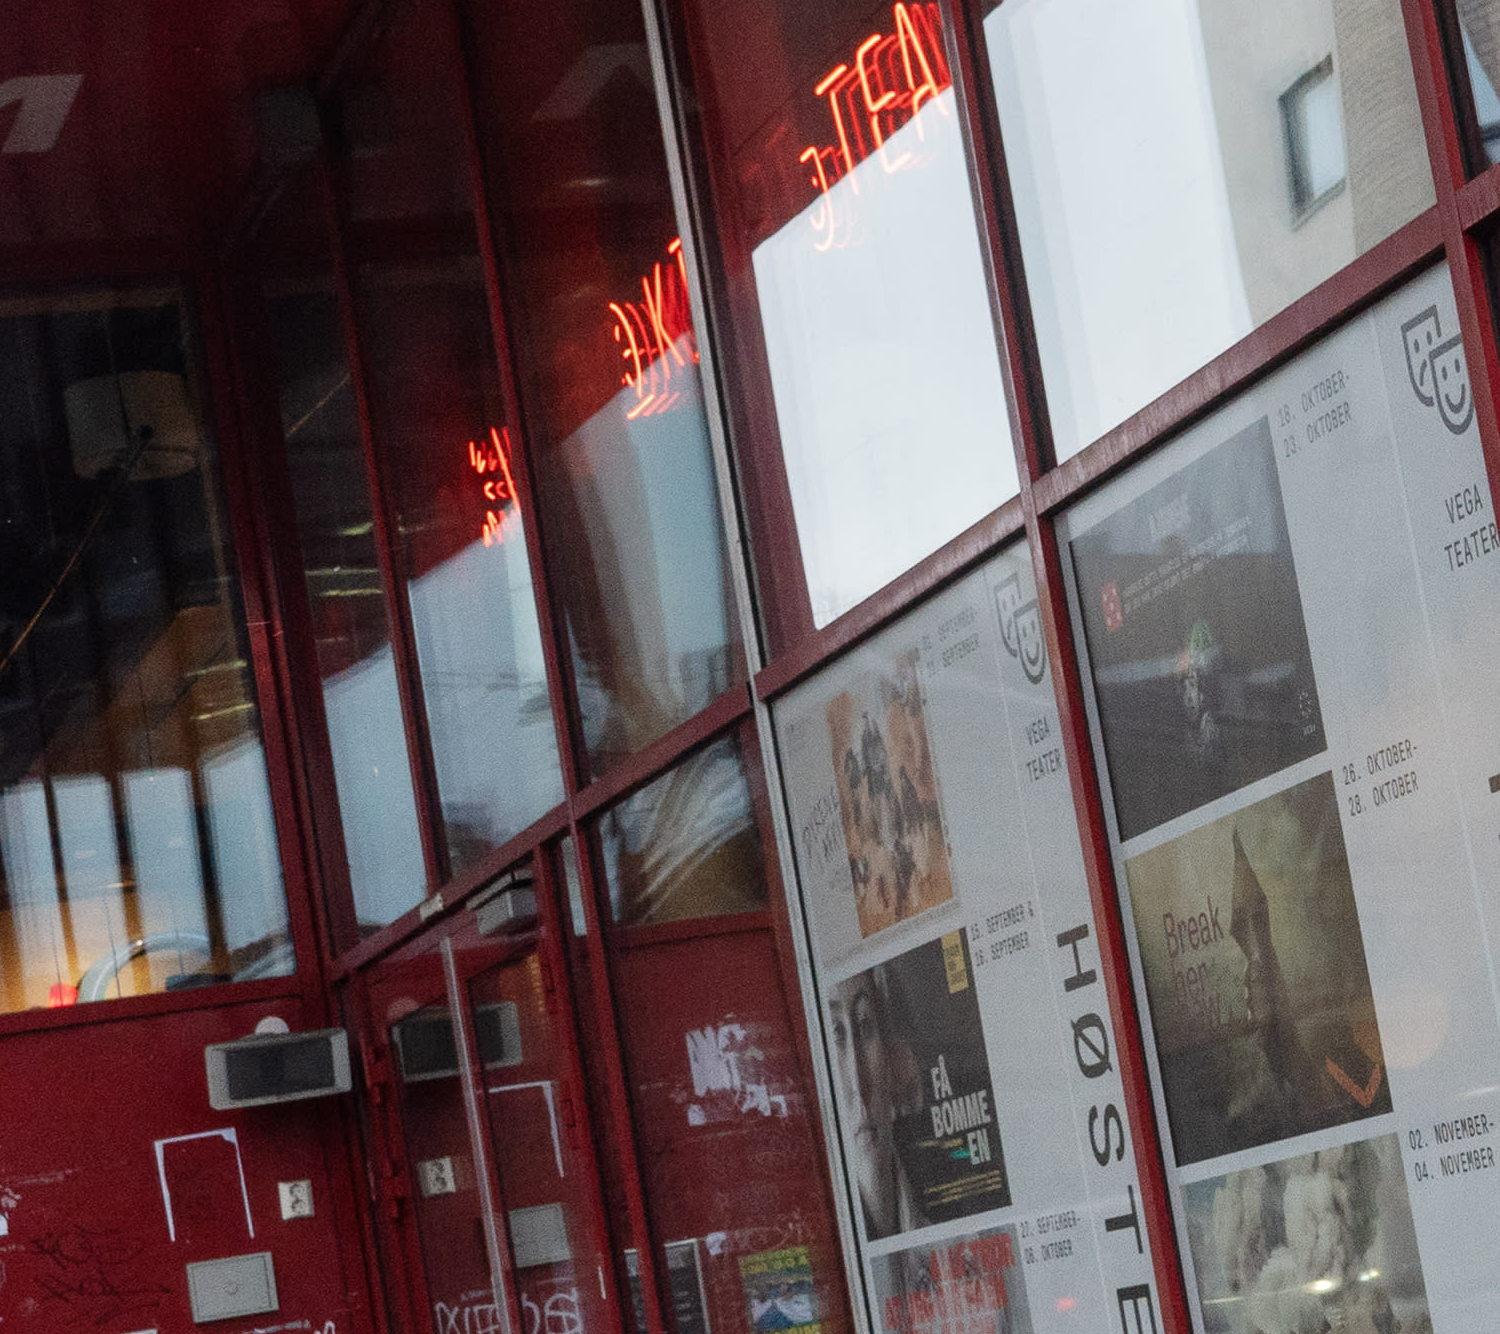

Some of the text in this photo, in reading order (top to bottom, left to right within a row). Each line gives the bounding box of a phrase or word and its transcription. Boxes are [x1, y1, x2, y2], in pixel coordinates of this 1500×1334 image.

[1306, 400, 1352, 446] OKTOBER
[1444, 483, 1485, 525] VEGA
[1443, 523, 1499, 573] TEATER
[1025, 718, 1051, 747] VEGA
[1025, 748, 1062, 782] TEATER
[1341, 763, 1361, 786] 26.
[1348, 772, 1419, 816] 28. OKTOBER
[1162, 895, 1225, 958] Break
[931, 1090, 992, 1139] BOMME
[1408, 1112, 1495, 1152] 02. NOVEMBER-
[967, 1127, 992, 1166] EN
[1414, 1146, 1496, 1183] 04. NOVEMBER
[1041, 1237, 1074, 1261] OKTOBER
